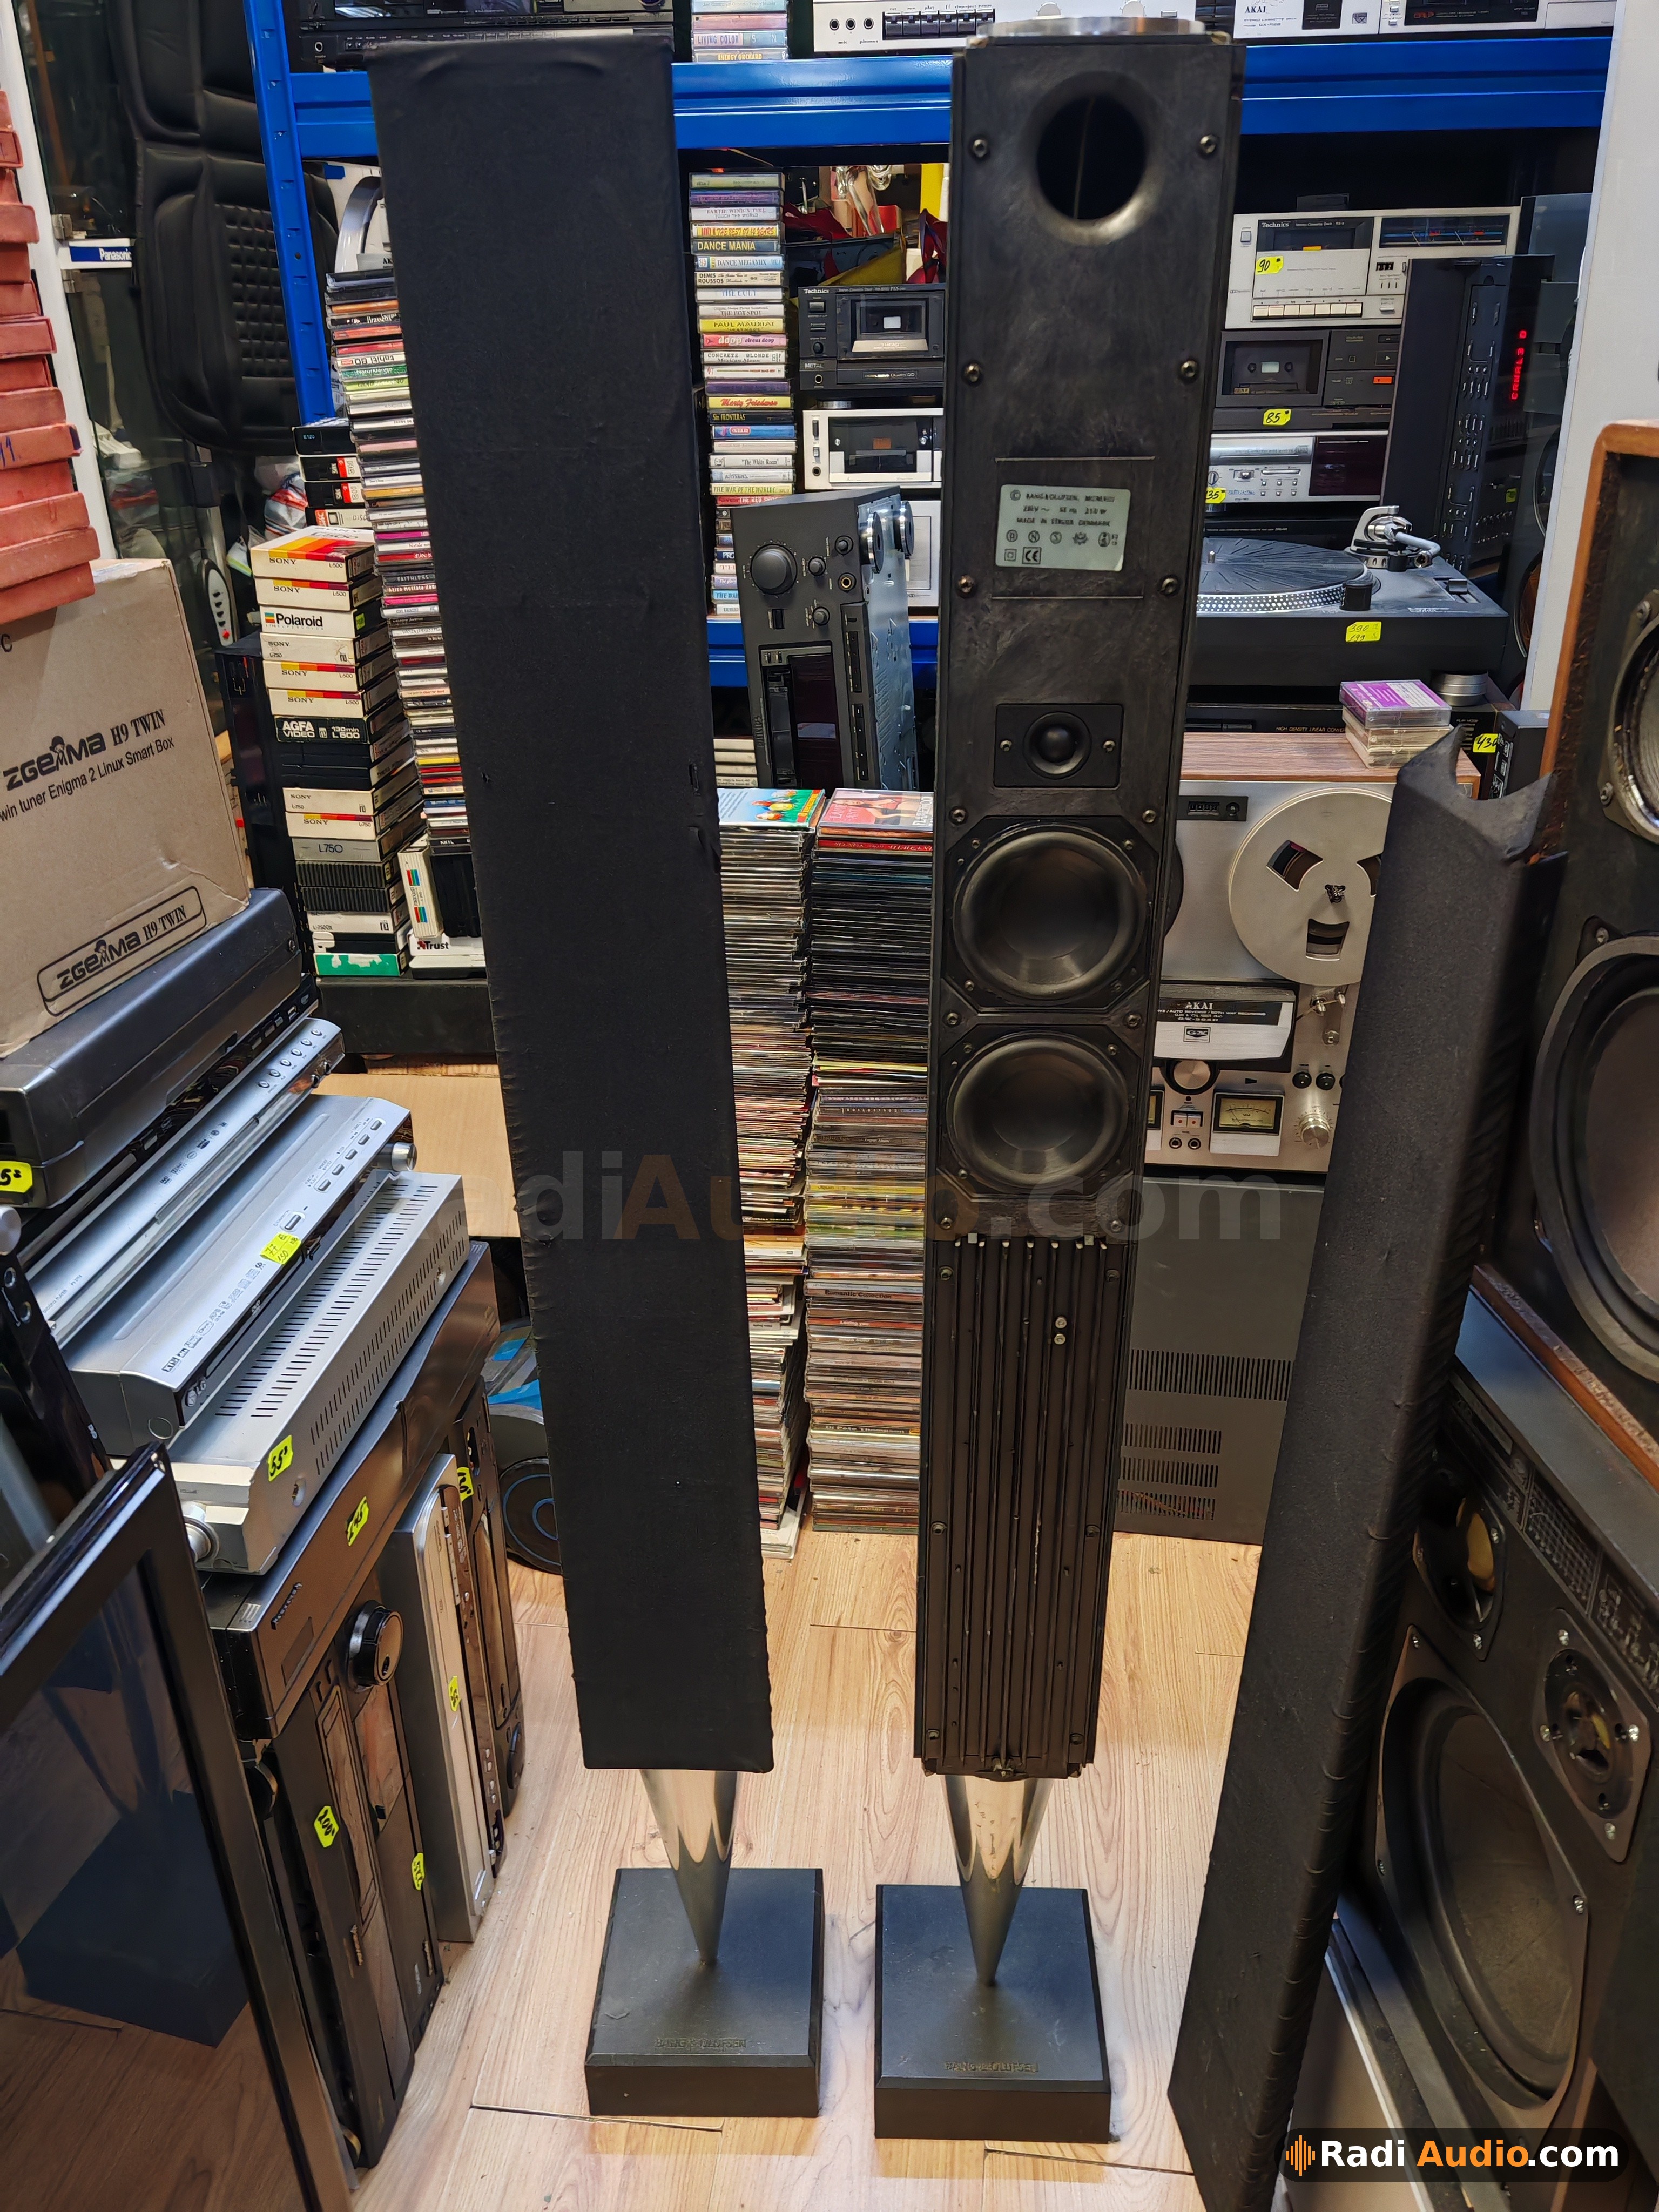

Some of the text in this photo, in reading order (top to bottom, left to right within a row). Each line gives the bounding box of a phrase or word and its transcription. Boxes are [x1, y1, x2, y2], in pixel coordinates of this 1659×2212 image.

[698, 35, 717, 45] LIVING
[697, 241, 756, 251] DANCE MANIA
[99, 248, 132, 262] Panasonic
[1257, 259, 1271, 273] 90
[1266, 413, 1281, 423] 85
[276, 613, 323, 628] Polaroid
[110, 709, 166, 747] H9 TWIN
[282, 721, 315, 731] AGFA
[19, 790, 48, 812] tuner
[49, 771, 88, 800] Enigma
[89, 768, 98, 783] 2
[98, 757, 125, 778] Linux
[126, 744, 155, 767] Smart
[157, 736, 176, 756] Box
[318, 844, 343, 853] L750
[143, 905, 188, 941] H9 TWIN
[426, 940, 449, 950] Trust
[1184, 1002, 1214, 1010] AKAI
[858, 1291, 892, 1299] Collection
